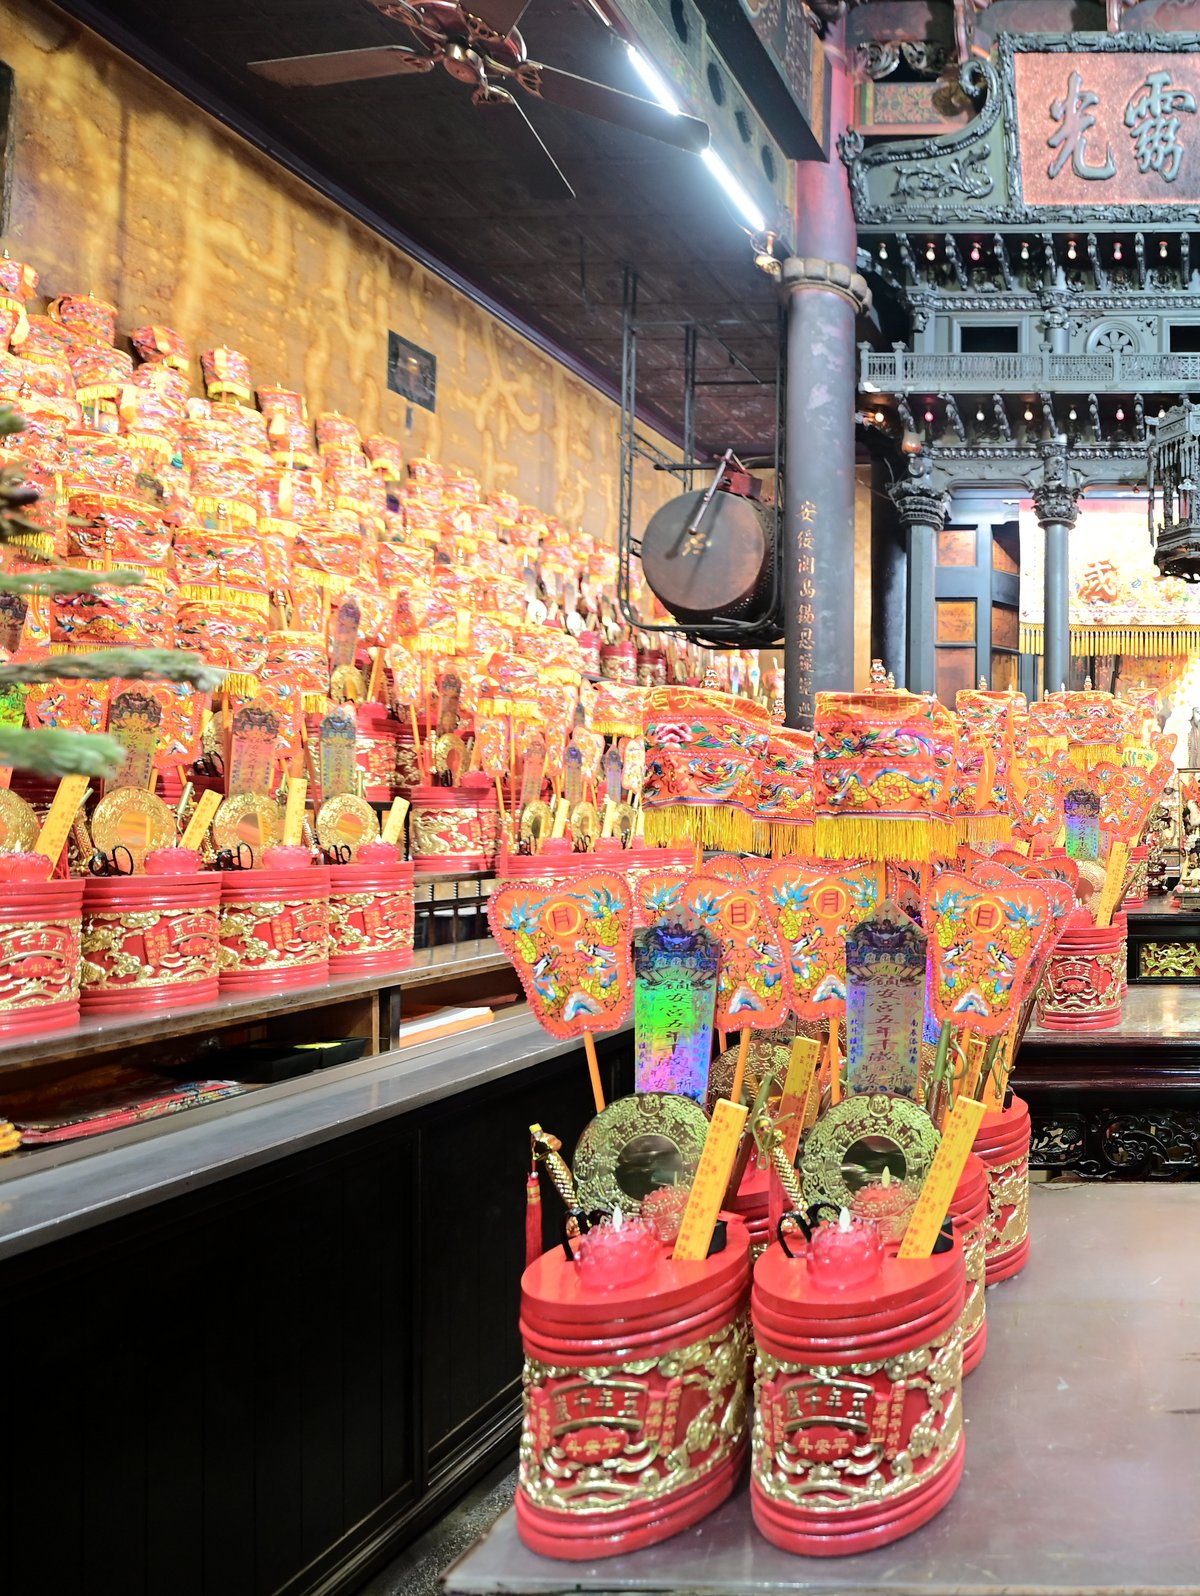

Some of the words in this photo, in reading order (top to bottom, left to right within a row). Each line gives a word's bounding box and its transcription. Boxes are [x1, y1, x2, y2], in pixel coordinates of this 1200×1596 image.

[821, 890, 839, 913] 月
[551, 907, 571, 933] 月
[730, 902, 747, 925] 日
[976, 904, 995, 928] 日
[785, 1386, 868, 1419] 五年千歲
[565, 1436, 622, 1458] 平安斗
[798, 1436, 850, 1456] 平安斗
